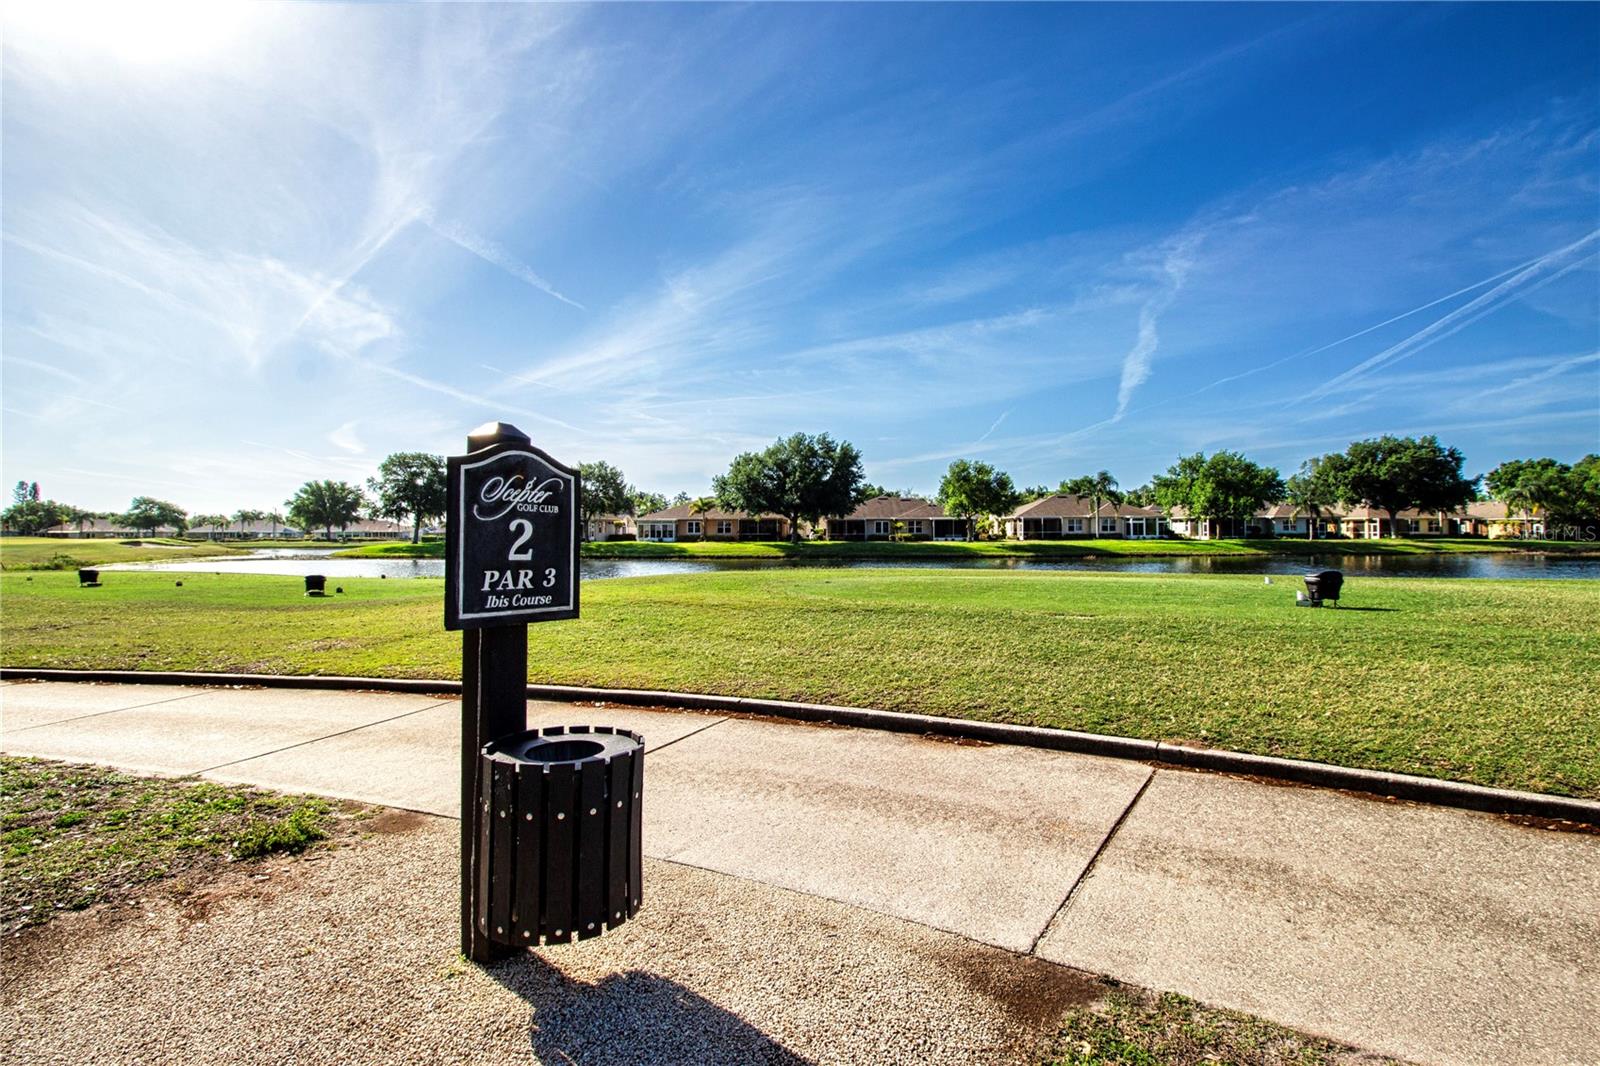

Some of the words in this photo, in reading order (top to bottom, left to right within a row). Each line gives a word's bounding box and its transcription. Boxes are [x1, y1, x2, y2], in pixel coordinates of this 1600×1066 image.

[473, 475, 563, 520] Scepter
[517, 503, 538, 512] GOLF
[540, 504, 559, 513] CLUB
[509, 519, 533, 561] 2
[481, 570, 534, 591] PAR
[543, 568, 556, 587] 3
[485, 595, 509, 608] Ibis
[512, 594, 552, 606] Course
